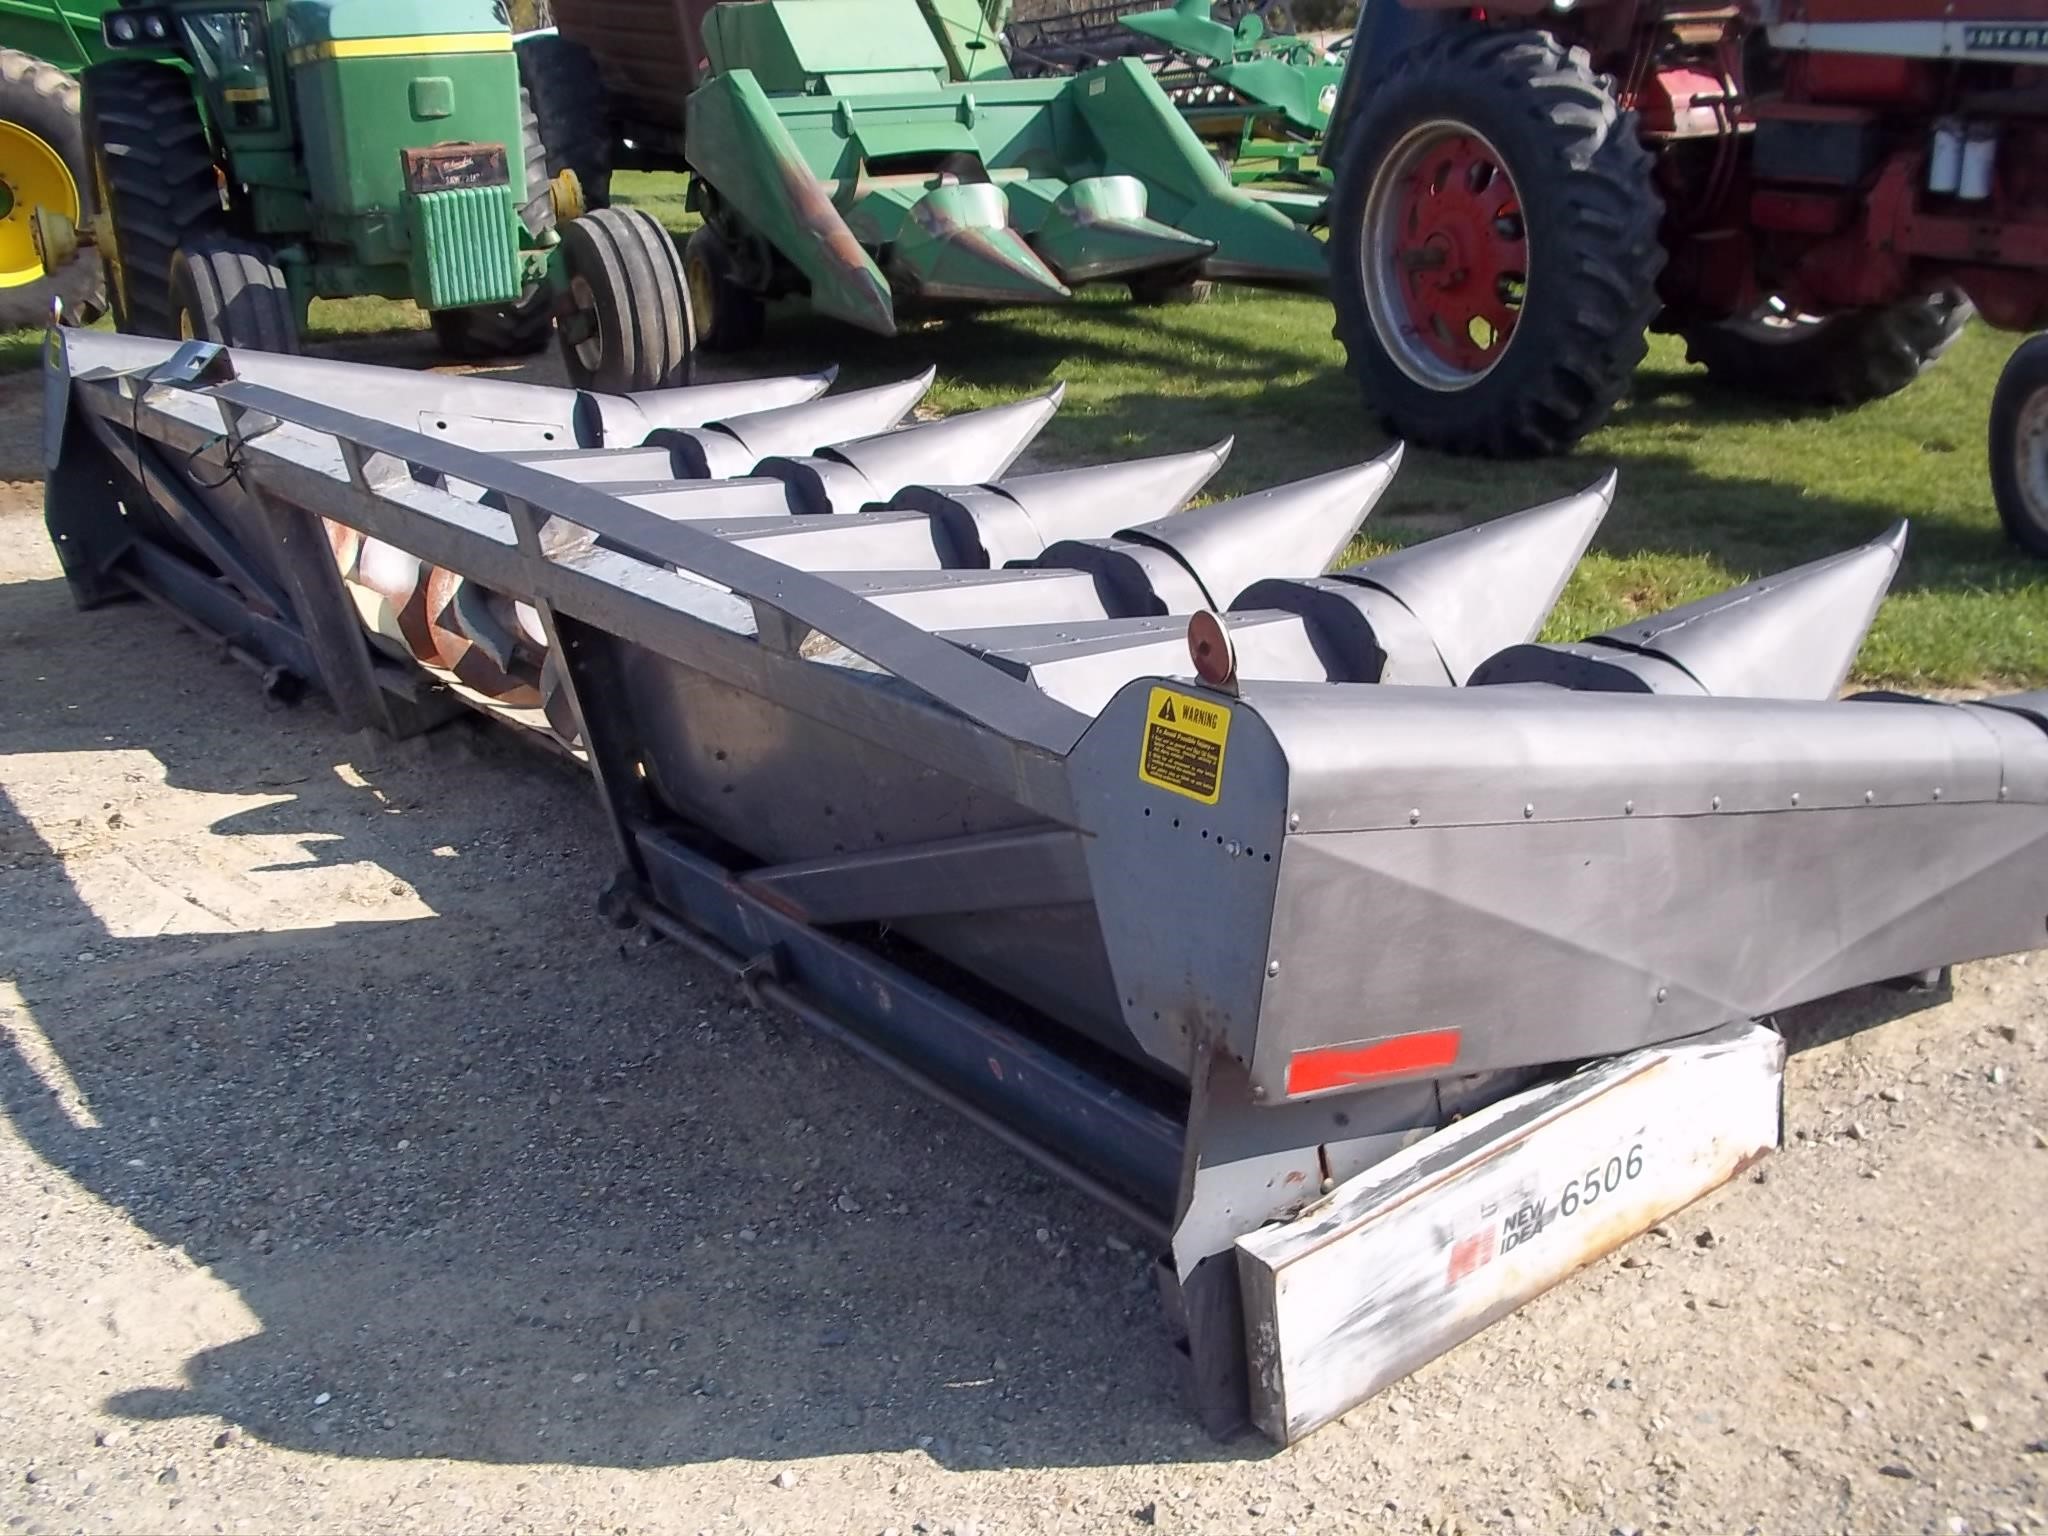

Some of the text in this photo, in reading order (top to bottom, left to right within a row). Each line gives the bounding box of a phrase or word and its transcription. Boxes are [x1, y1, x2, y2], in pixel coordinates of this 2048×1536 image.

[1183, 704, 1218, 729] WARNING
[1560, 1143, 1644, 1217] 6506
[1502, 1196, 1546, 1235] NEW
[1499, 1219, 1543, 1255] IDEA
